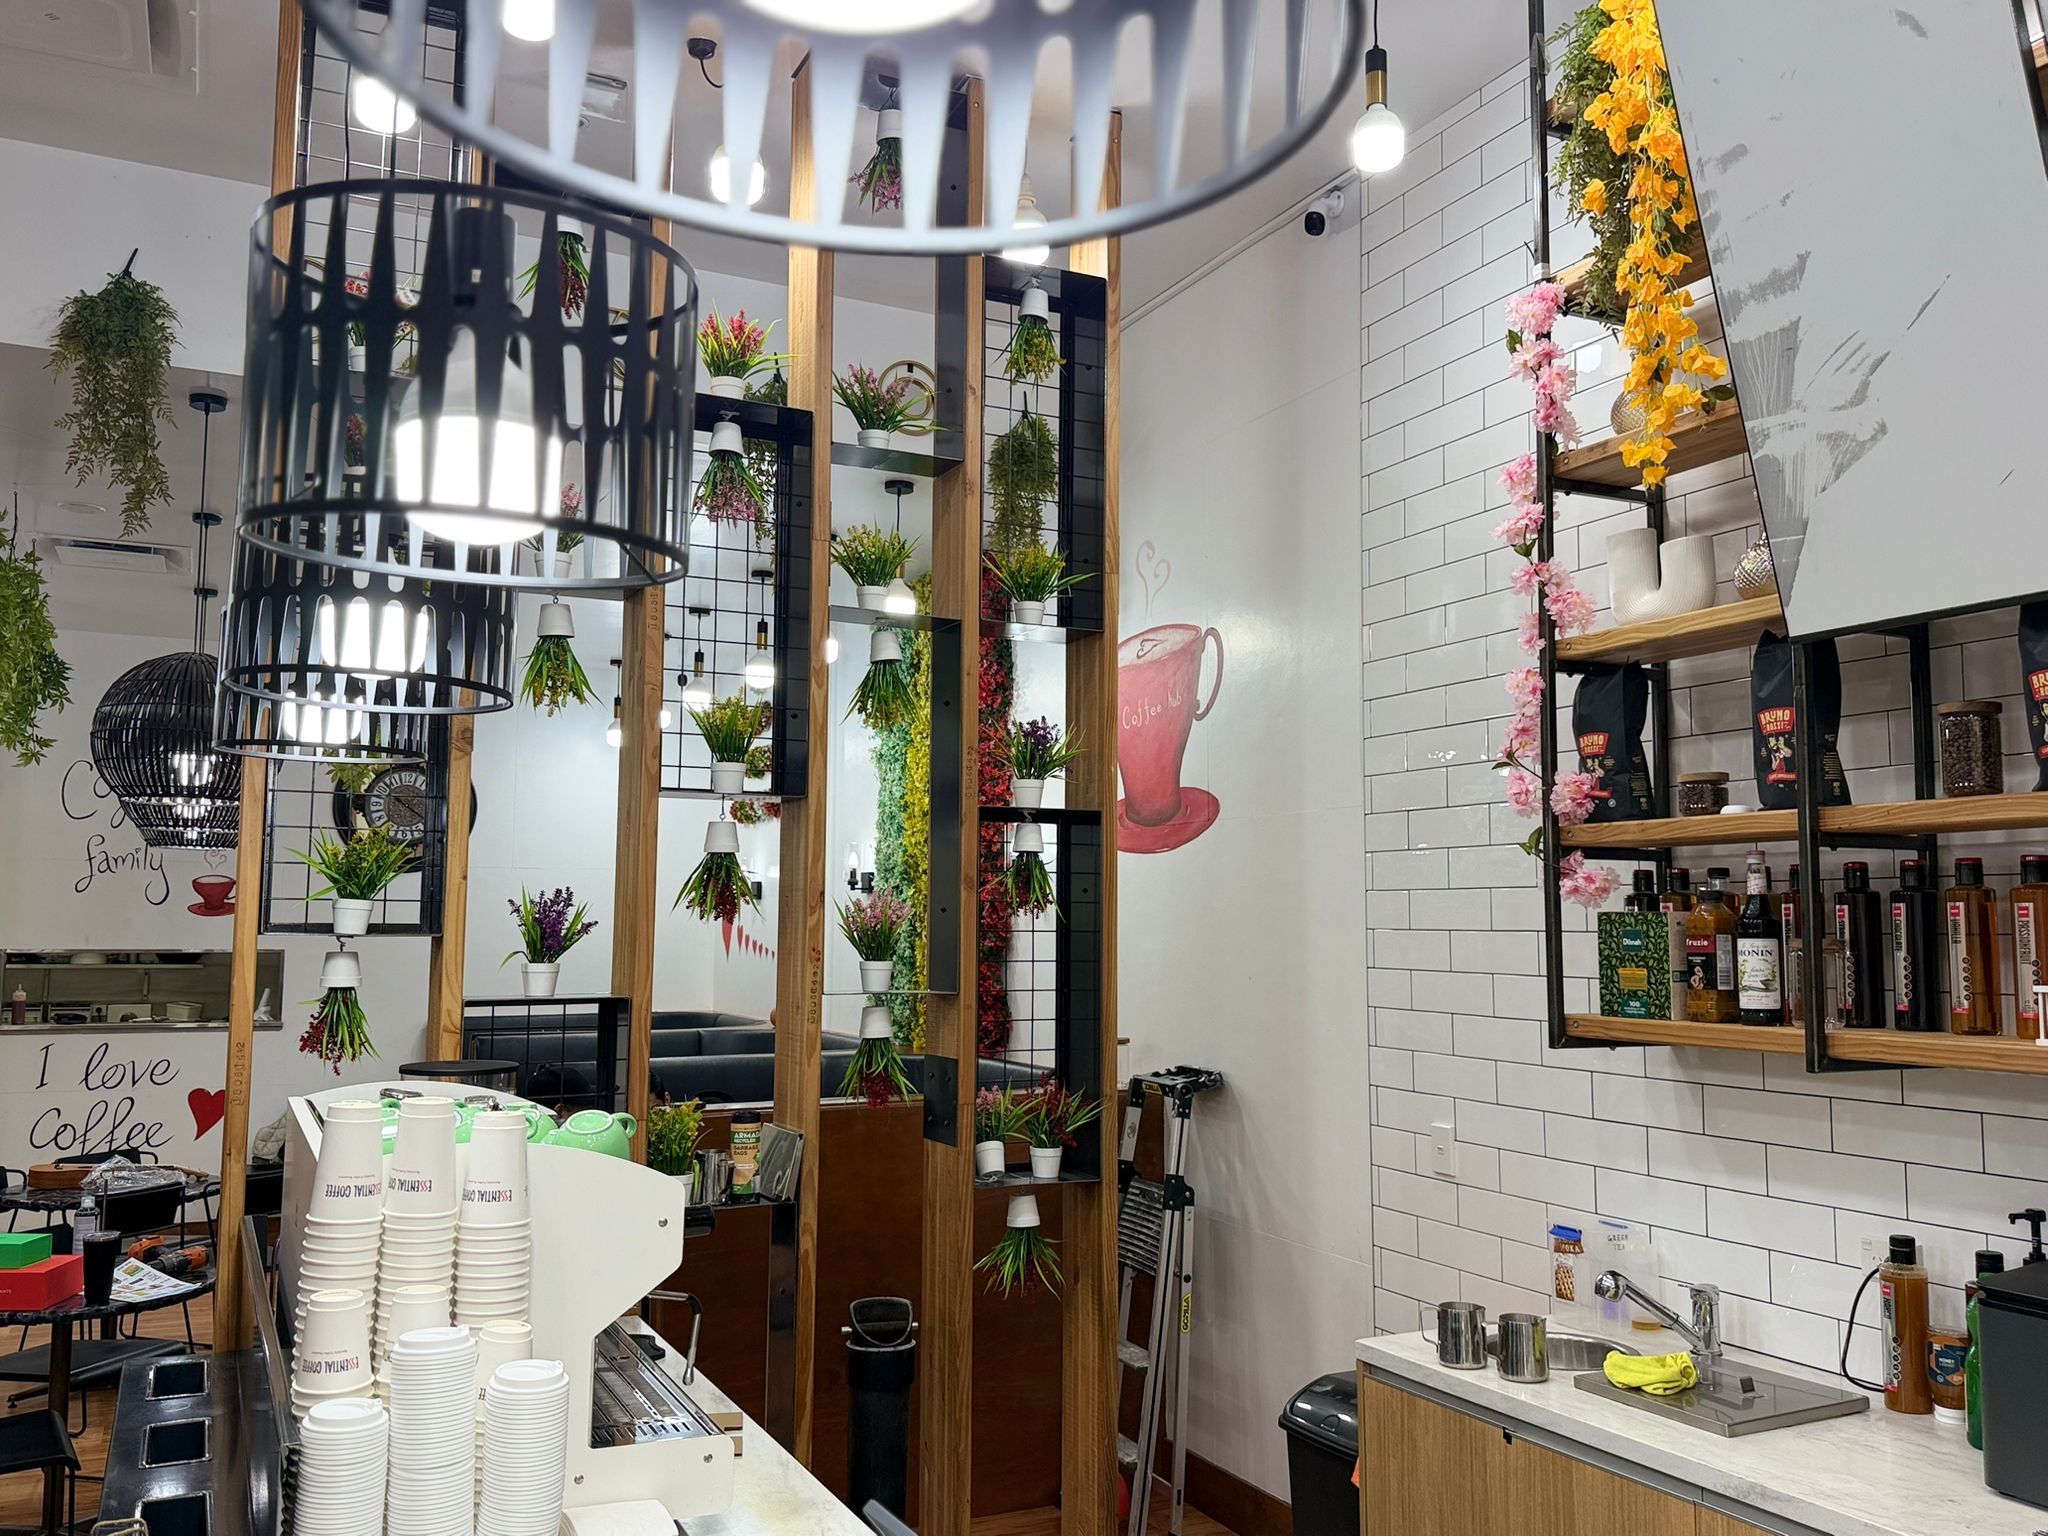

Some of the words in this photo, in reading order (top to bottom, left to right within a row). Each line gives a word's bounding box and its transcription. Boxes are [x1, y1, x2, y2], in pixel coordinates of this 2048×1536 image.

[1122, 697, 1163, 729] Coffee
[1167, 687, 1182, 709] hub
[1760, 709, 1791, 725] BRUNO
[1580, 734, 1604, 748] BRUNO
[404, 774, 413, 784] 12
[75, 834, 170, 905] family
[1951, 919, 1962, 945] VANILLA
[1623, 938, 1642, 946] Dilmah
[1685, 938, 1709, 947] fruzio
[2018, 920, 2032, 965] PASSIONFRUIT
[1629, 1000, 1641, 1008] 100
[35, 1043, 55, 1089] I
[78, 1042, 180, 1091] love
[29, 1096, 175, 1157] Coffee
[325, 1184, 351, 1198] COFFEE
[397, 1178, 433, 1193] ESSENTIAL
[477, 1189, 512, 1202] ESSENTIAL
[324, 1356, 359, 1374] ESSENTIAL
